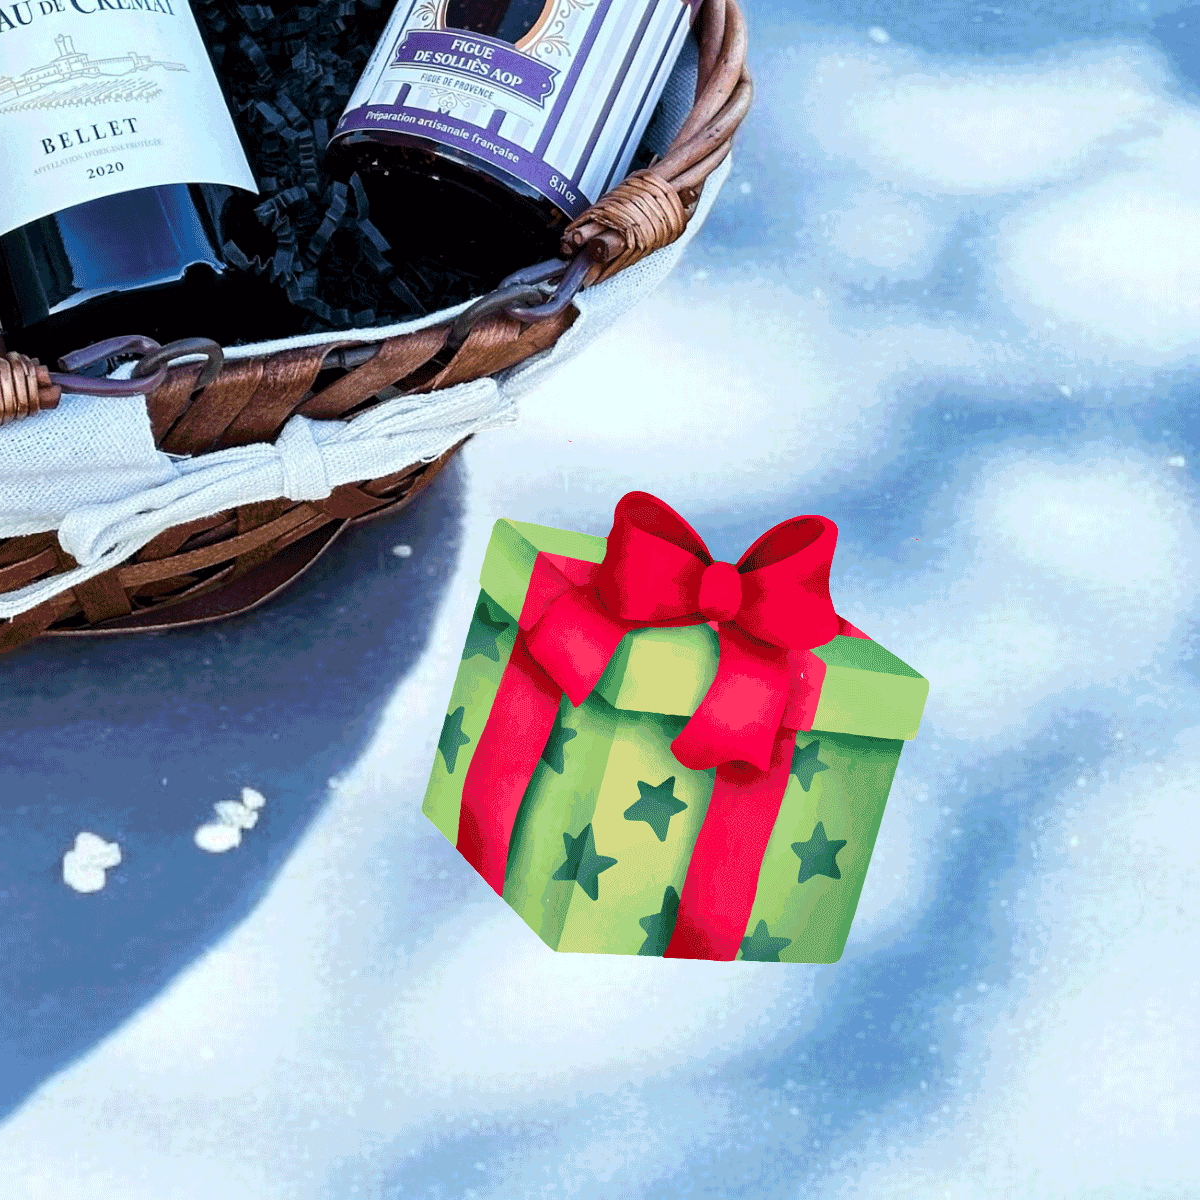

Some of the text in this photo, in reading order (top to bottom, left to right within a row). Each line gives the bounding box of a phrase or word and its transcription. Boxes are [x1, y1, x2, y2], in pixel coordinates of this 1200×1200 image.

[450, 38, 495, 60] FIGUE
[413, 50, 523, 88] DE SOLLIÈS AOP
[420, 72, 495, 100] FIGUE DE PROVENCE
[40, 117, 138, 155] BELLET
[365, 110, 416, 125] Préparation
[417, 118, 470, 140] artisanale
[470, 131, 520, 164] française
[86, 161, 125, 180] 2020
[565, 190, 577, 205] oz
